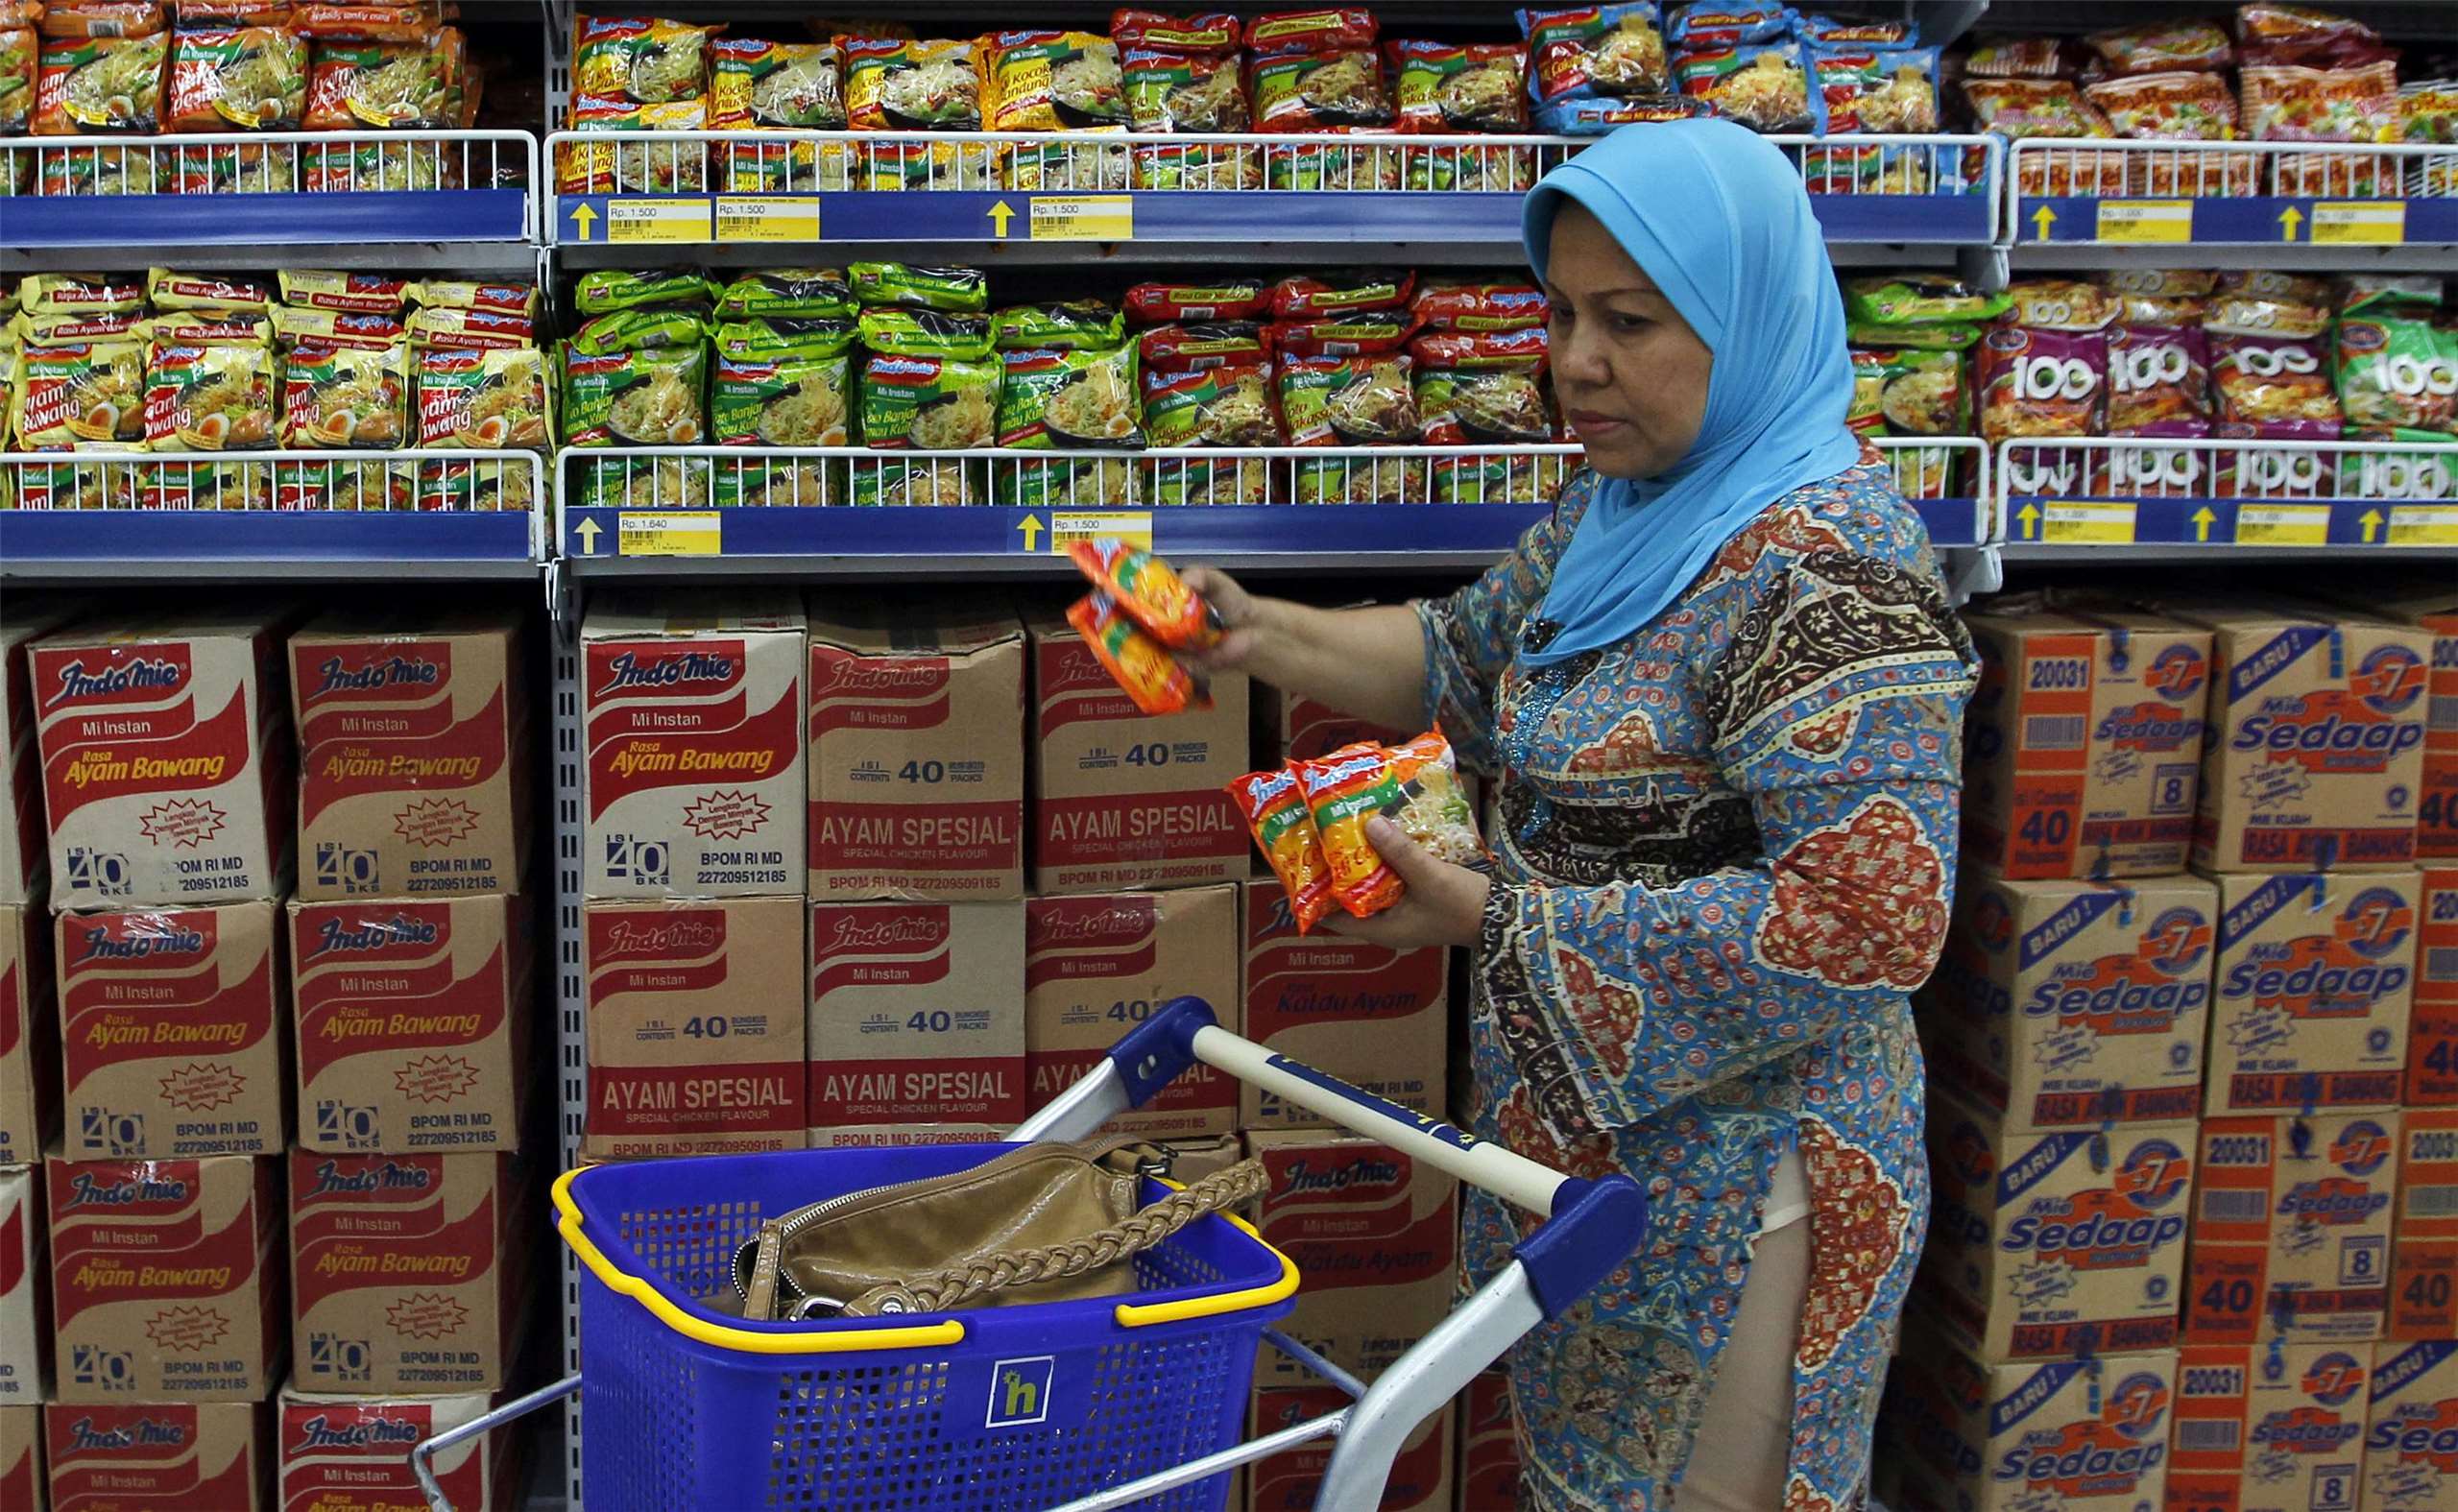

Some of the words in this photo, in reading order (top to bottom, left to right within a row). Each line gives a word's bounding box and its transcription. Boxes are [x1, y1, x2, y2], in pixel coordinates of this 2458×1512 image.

[1014, 66, 1051, 83] Kocok
[611, 208, 627, 217] Rp.
[720, 205, 735, 214] Rp.
[739, 205, 765, 214] 1.500
[2012, 356, 2096, 401] 100
[2109, 343, 2189, 393] 100
[622, 519, 638, 528] Rp.
[2031, 660, 2087, 688] 20031
[83, 722, 101, 736] Mi
[104, 721, 151, 734] Instan
[342, 718, 359, 732] Mi
[363, 718, 408, 731] Instan
[632, 713, 649, 726] Mi
[654, 713, 701, 726] Instan
[2231, 714, 2424, 756] Sedaap
[83, 752, 112, 762] Rasa
[630, 742, 660, 752] Rasa
[1125, 744, 1169, 766] 40
[64, 761, 127, 788] Ayam
[132, 756, 225, 780] Bawang
[323, 756, 385, 782] Ayam
[389, 756, 480, 780] Bawang
[610, 750, 675, 778] Ayam
[679, 750, 774, 773] Bawang
[899, 760, 944, 783] 40
[2165, 779, 2182, 803] 8
[821, 817, 893, 845] AYAM
[903, 816, 1011, 846] SPESIAL
[1050, 810, 1121, 841] AYAM
[1130, 804, 1234, 836] SPESIAL
[2021, 811, 2070, 846] 40
[317, 851, 379, 886] 40
[411, 860, 449, 873] BPOM
[454, 859, 468, 872] RI
[471, 858, 492, 871] MD
[607, 842, 668, 876] 40
[701, 852, 741, 865] BPOM
[745, 852, 758, 865] RI
[761, 852, 783, 864] MD
[68, 853, 131, 888] 40
[697, 871, 786, 883] 227209512185
[408, 876, 496, 891] 227209512185
[830, 877, 868, 889] BPOM
[873, 877, 884, 887] RI
[888, 876, 909, 887] MD
[2247, 945, 2294, 960] Mie
[630, 975, 643, 986] Mi
[648, 975, 686, 985] Instan
[854, 969, 867, 979] Mi
[872, 969, 909, 979] Instan
[2053, 965, 2096, 978] Mie
[2220, 959, 2407, 999] Sedaap
[106, 986, 123, 998] Mi
[127, 986, 174, 998] Instan
[2022, 977, 2207, 1018] Sedaap
[320, 1016, 384, 1043] Ayam
[388, 1014, 480, 1037] Bawang
[684, 1017, 728, 1039] 40
[906, 1011, 950, 1032] 40
[86, 1023, 149, 1049] Ayam
[154, 1021, 247, 1044] Bawang
[604, 1082, 675, 1110] AYAM
[685, 1078, 792, 1108] SPESIAL
[824, 1074, 896, 1101] AYAM
[904, 1072, 1010, 1099] SPESIAL
[626, 1114, 669, 1122] SPECIAL
[673, 1112, 719, 1121] CHICKEN
[721, 1111, 769, 1120] FLAVOUR
[846, 1105, 888, 1114] SPECIAL
[892, 1104, 936, 1114] CHICKEN
[940, 1103, 988, 1113] FLAVOUR
[317, 1106, 379, 1141] 40
[411, 1115, 449, 1128] BPOM
[454, 1115, 467, 1126] RI
[470, 1114, 492, 1125] MD
[408, 1131, 496, 1145] 227209512185
[833, 1135, 871, 1146] BPOM
[876, 1135, 887, 1145] RI
[891, 1134, 910, 1145] MD
[92, 1231, 109, 1243] Mi
[112, 1231, 158, 1243] Instan
[2000, 1212, 2185, 1254] Sedaap
[315, 1253, 376, 1278] Ayam
[381, 1253, 470, 1278] Bawang
[2354, 1250, 2371, 1274] 8
[72, 1265, 134, 1291] Ayam
[139, 1267, 230, 1289] Bawang
[2201, 1280, 2253, 1312] 40
[2404, 1275, 2449, 1308] 40
[1991, 1443, 2163, 1482] Sedaap
[325, 1468, 341, 1481] Mi
[345, 1469, 391, 1481] Instan
